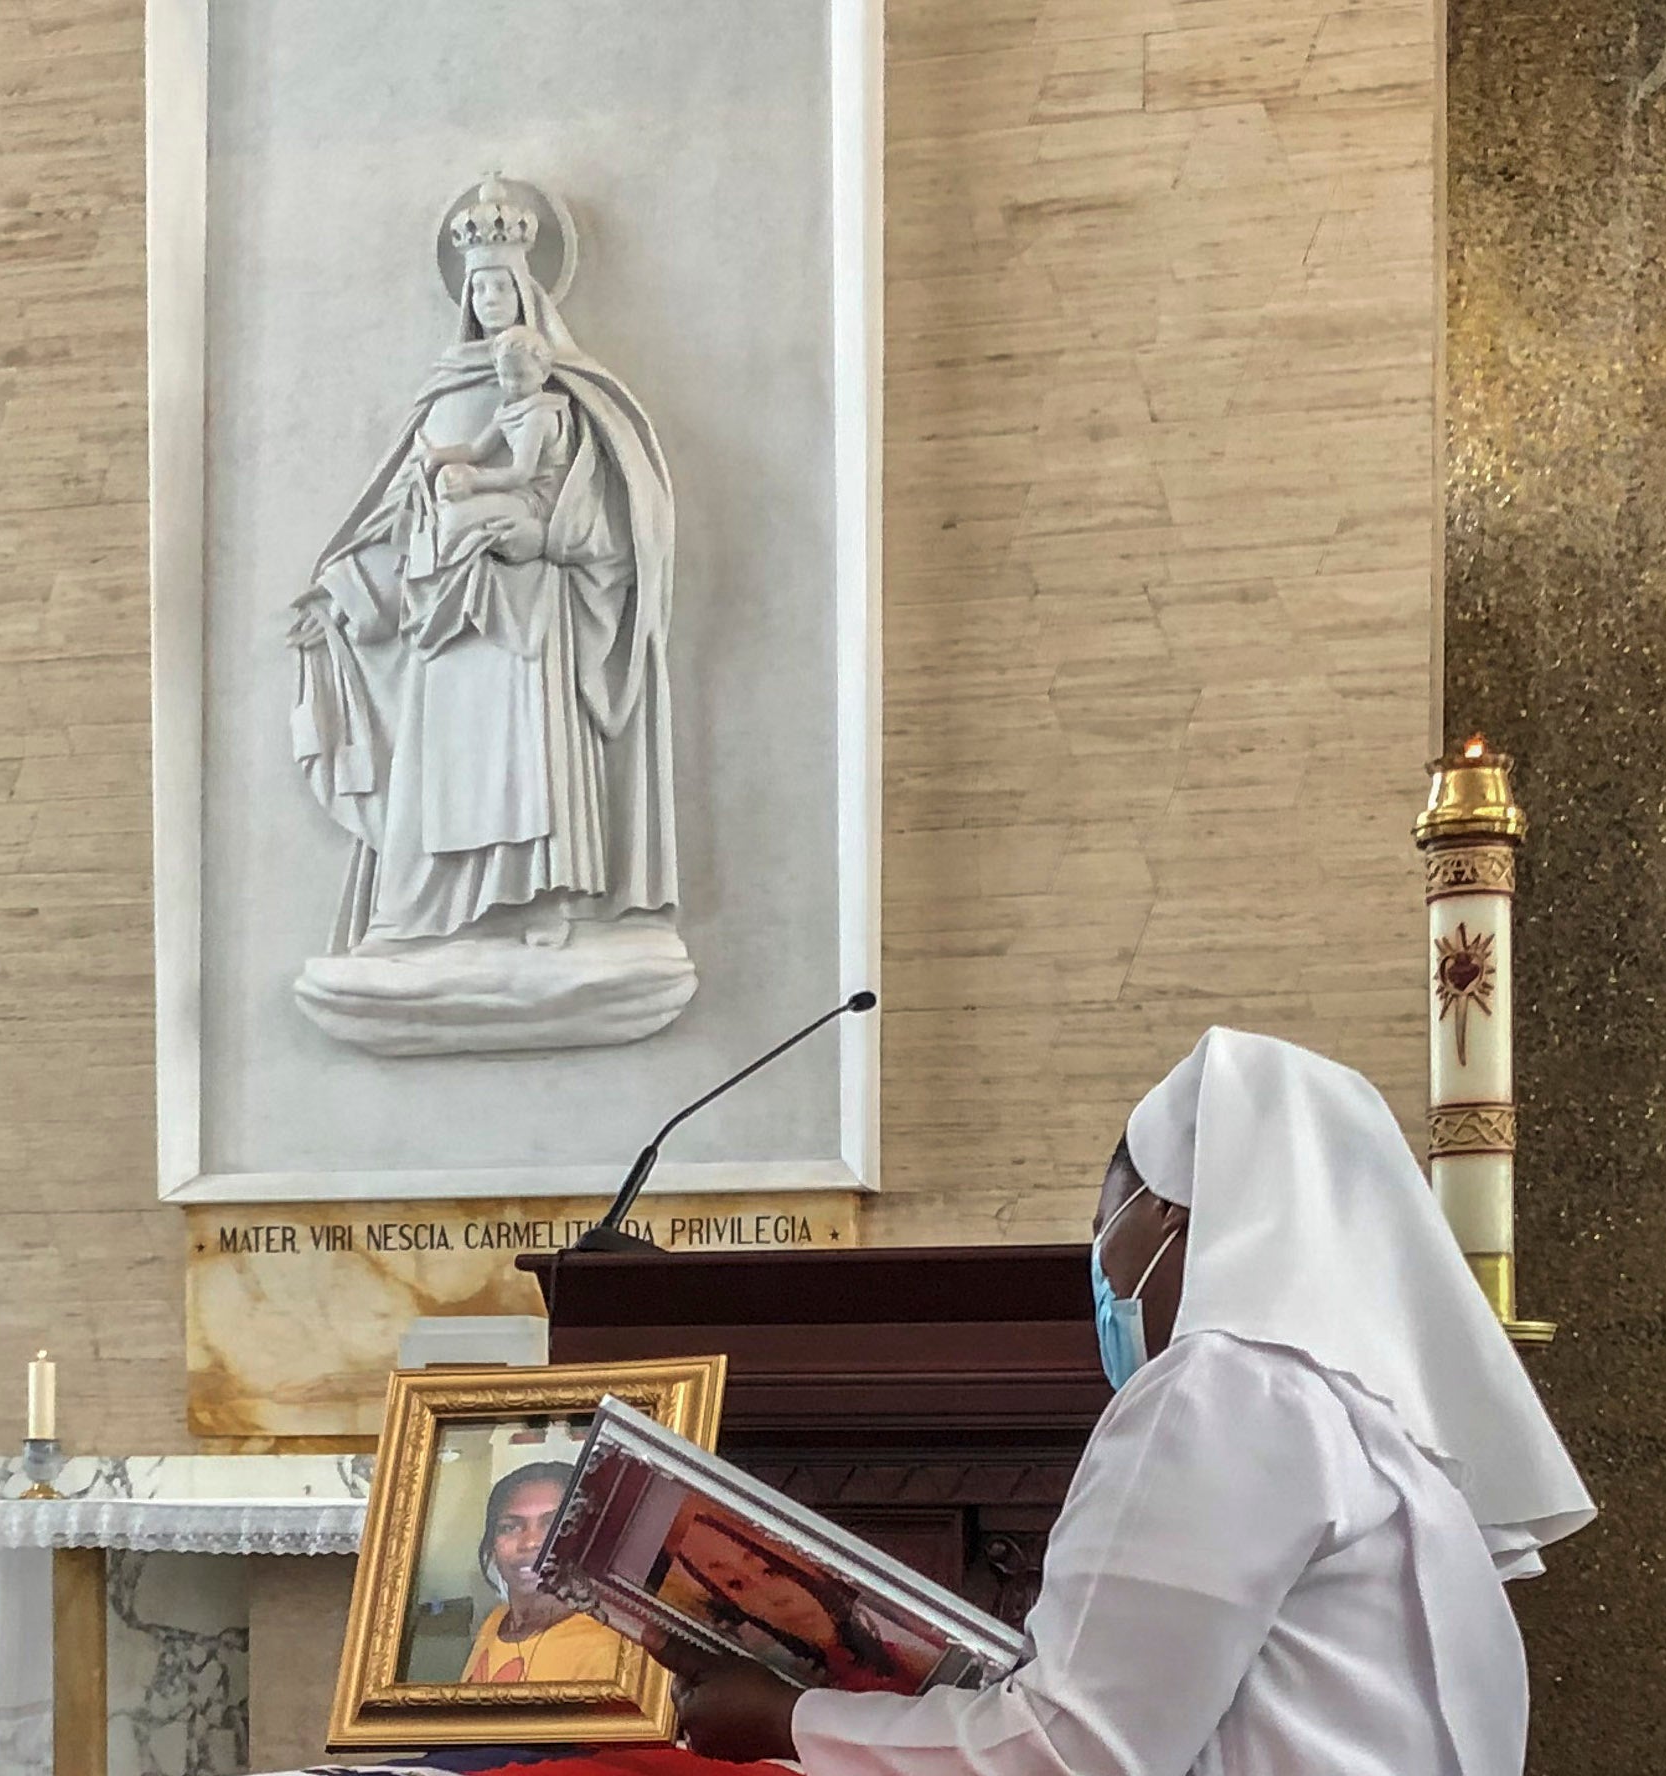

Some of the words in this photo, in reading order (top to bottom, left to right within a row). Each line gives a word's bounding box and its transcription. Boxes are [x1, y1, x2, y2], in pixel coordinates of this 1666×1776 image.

[309, 1224, 354, 1252] VIRI
[463, 1220, 601, 1249] CARMELIT
[625, 1219, 654, 1245] DA
[670, 1215, 813, 1246] PRIVILEGIA
